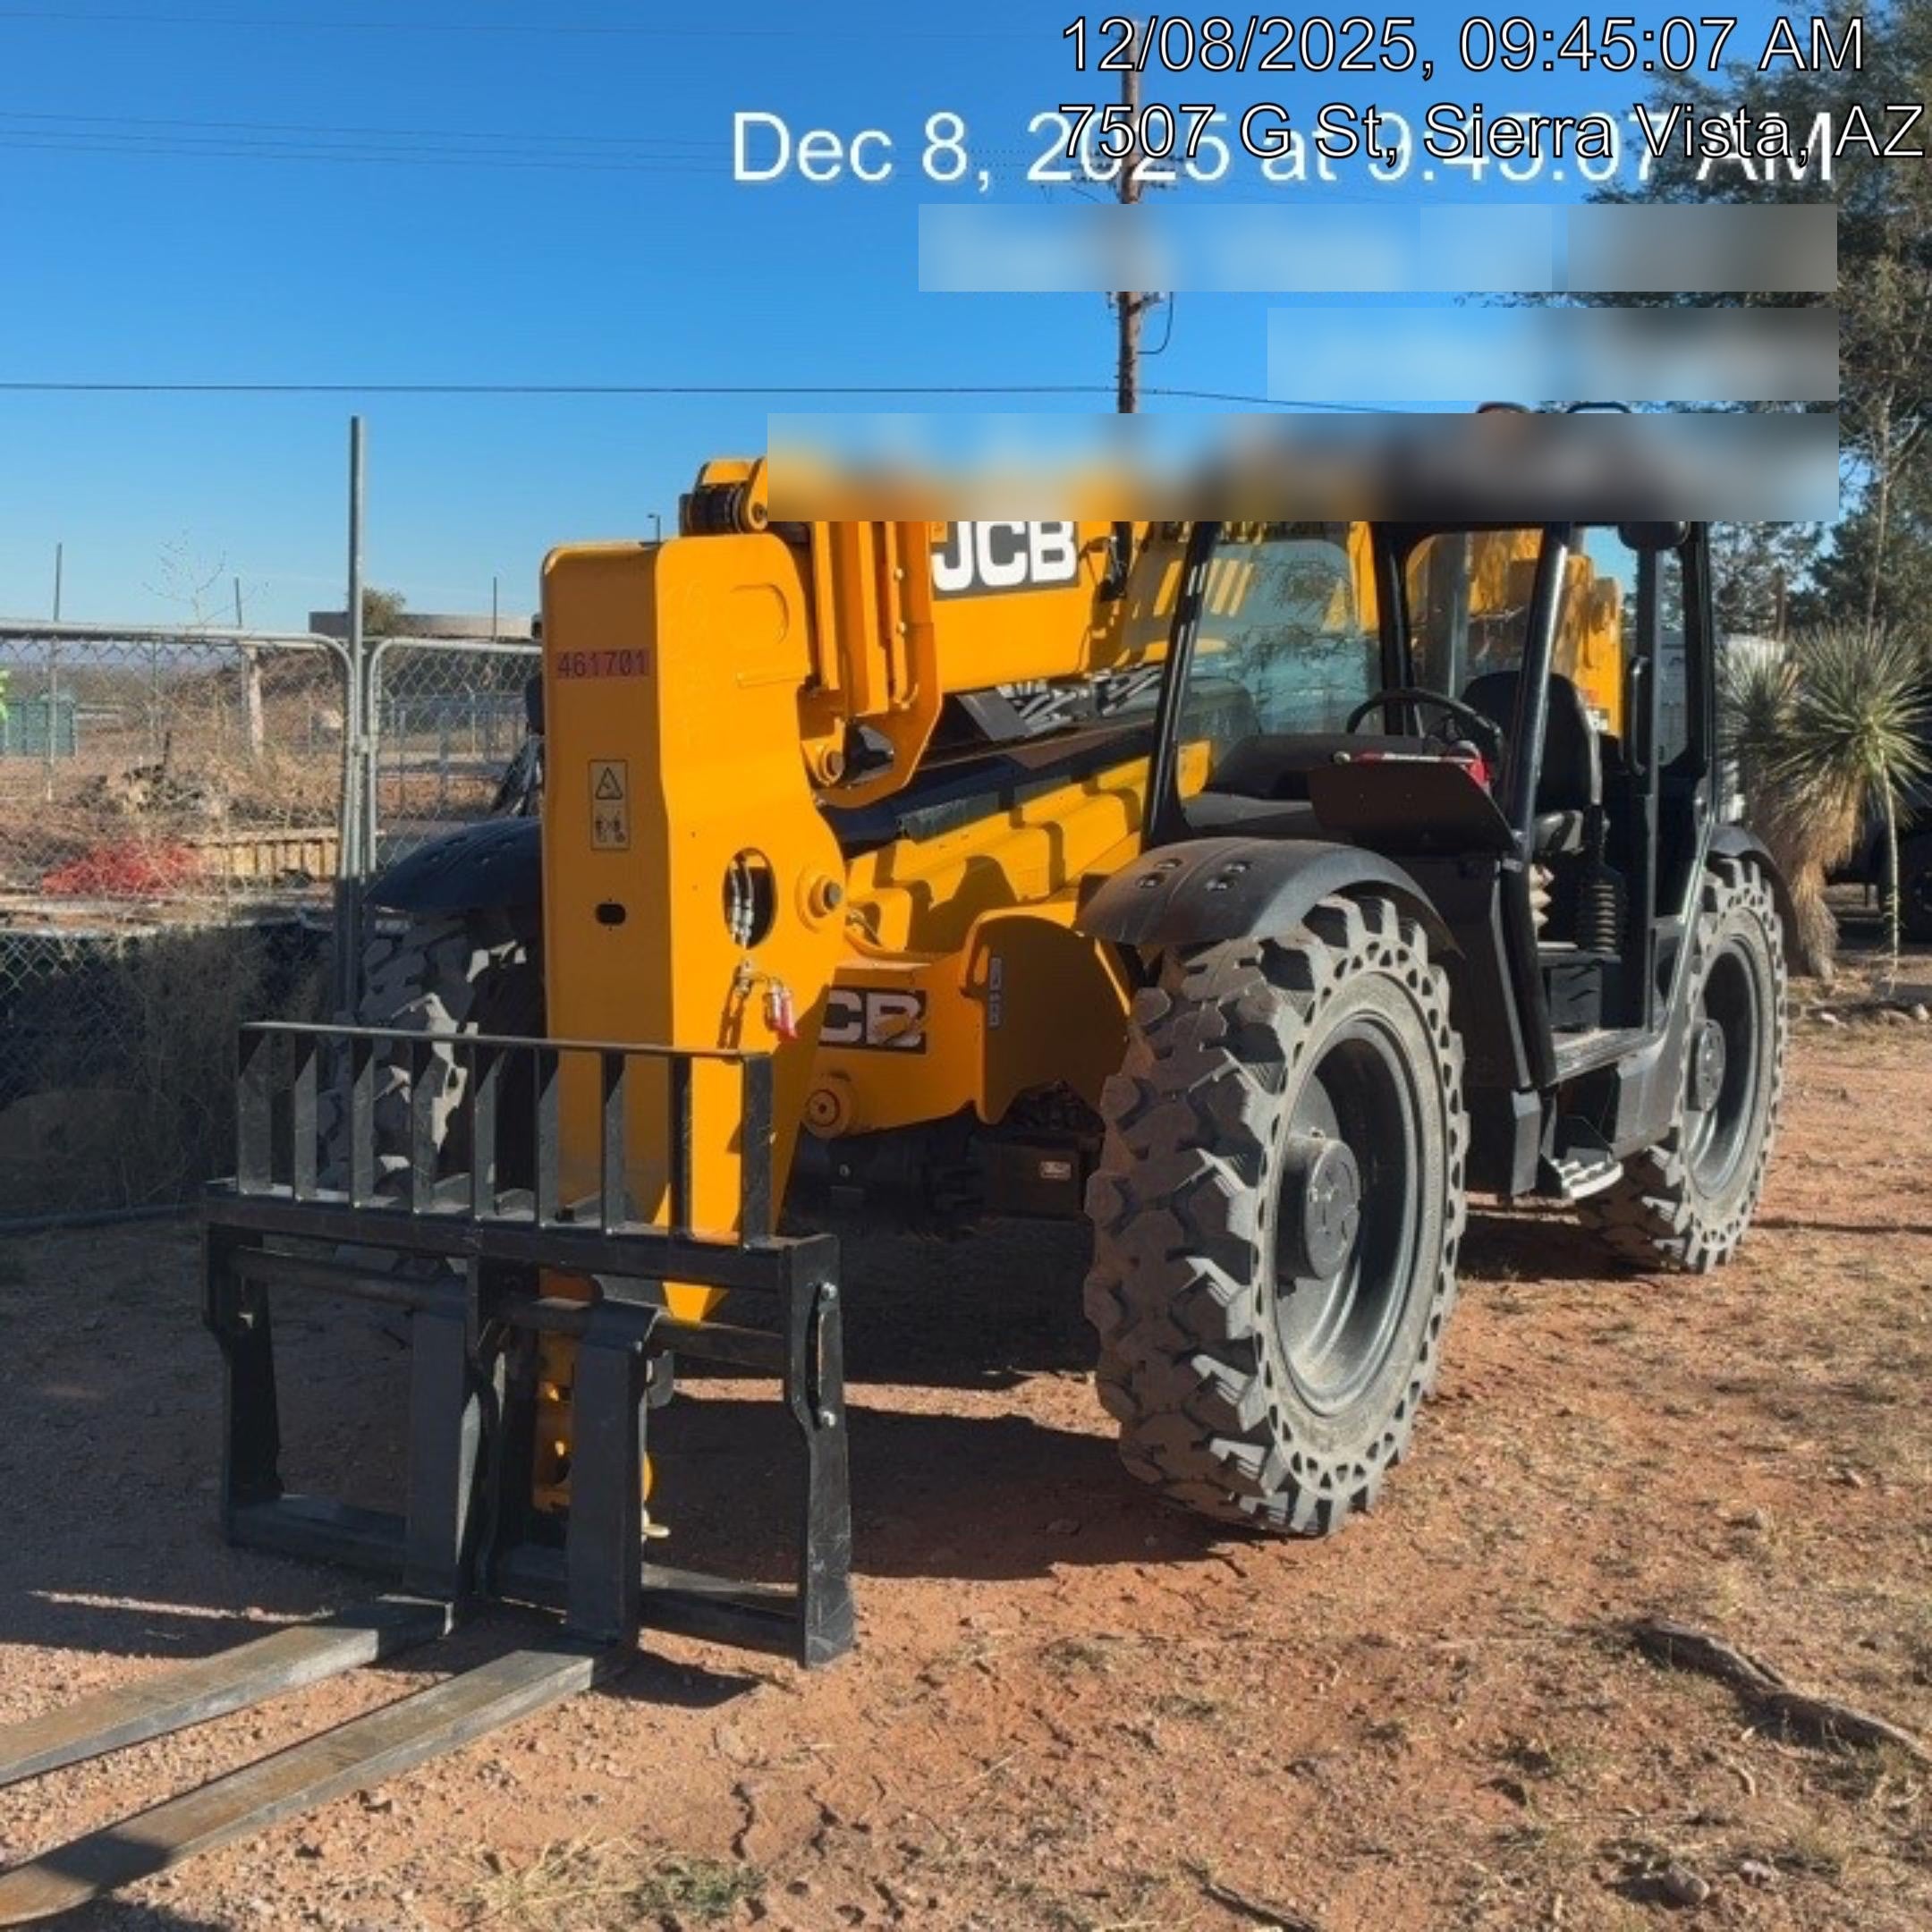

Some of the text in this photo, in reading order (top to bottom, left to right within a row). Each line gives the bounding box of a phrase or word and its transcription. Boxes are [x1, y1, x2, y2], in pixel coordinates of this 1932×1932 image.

[930, 521, 1077, 591] JCB
[557, 649, 648, 677] 461701
[820, 988, 921, 1046] CB
